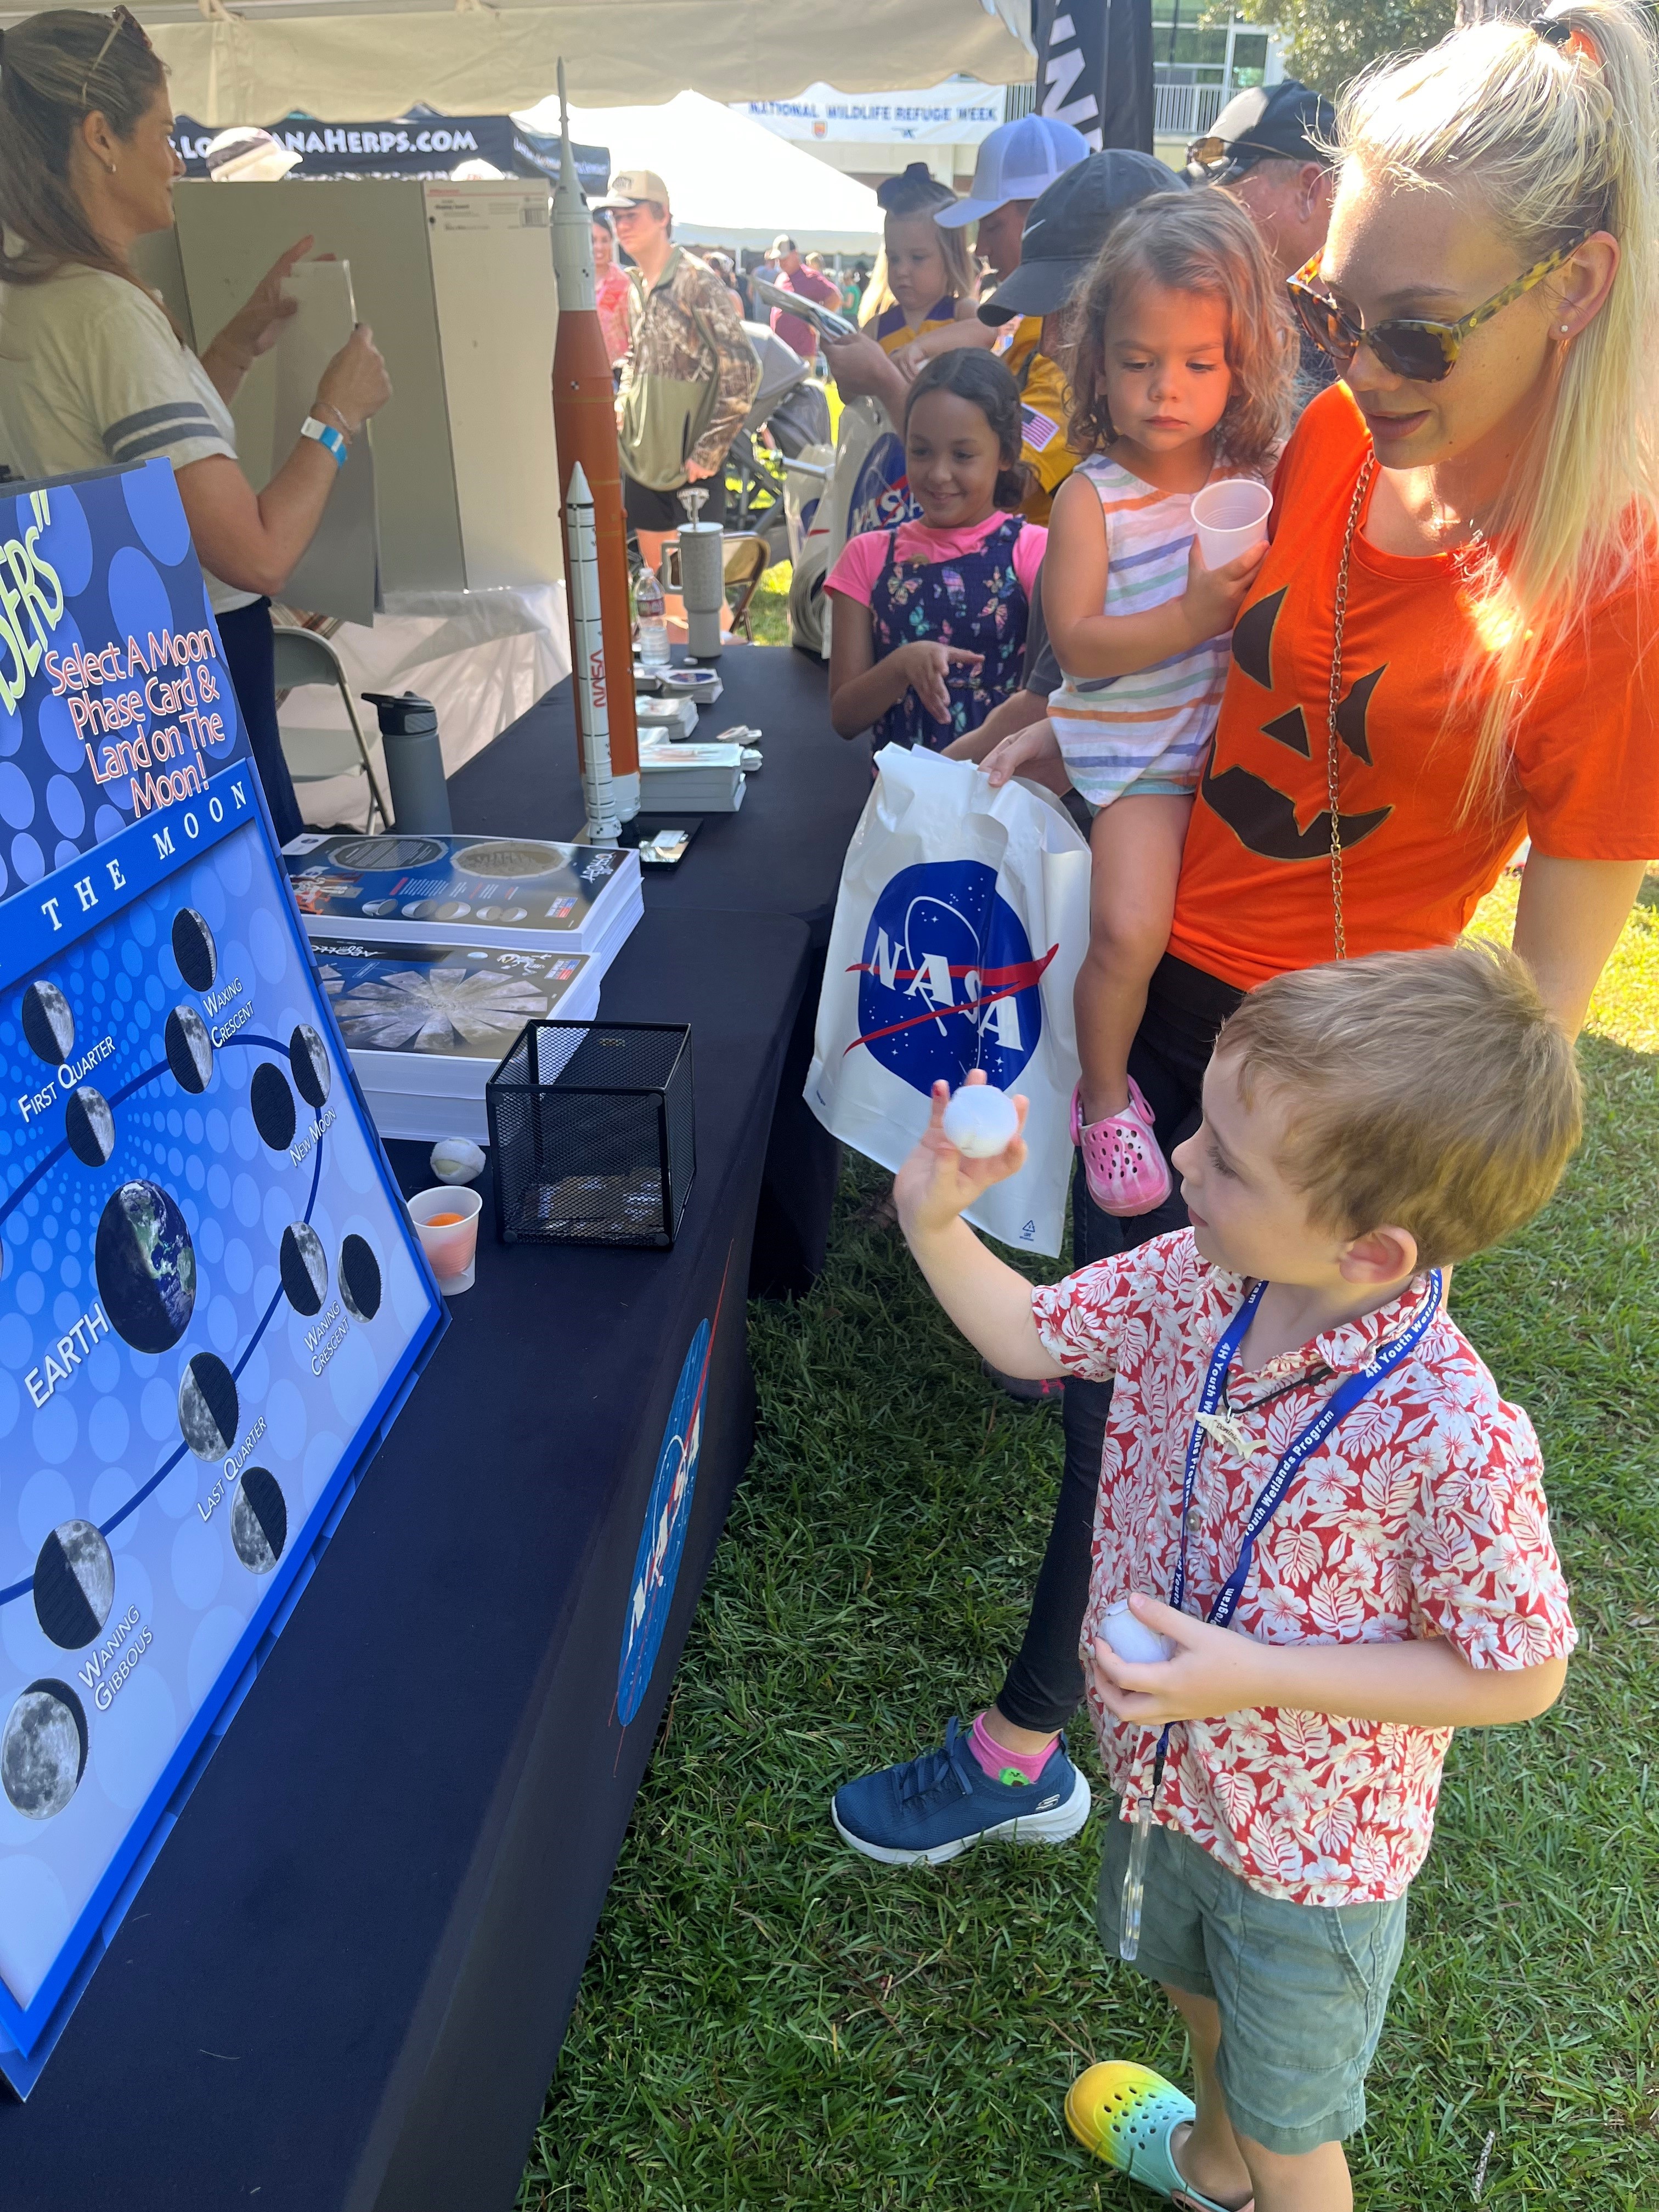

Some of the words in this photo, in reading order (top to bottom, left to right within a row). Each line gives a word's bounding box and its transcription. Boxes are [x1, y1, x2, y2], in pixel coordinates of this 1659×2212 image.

[749, 101, 819, 118] NATIONAL
[826, 104, 891, 121] WILDLIFE
[894, 106, 951, 122] REFUGE
[958, 106, 997, 122] WEEK
[45, 642, 126, 696] Select
[128, 635, 150, 677] A
[148, 629, 216, 672] Moon
[590, 649, 607, 708] NASA
[67, 690, 146, 740] Phase
[145, 665, 198, 715] Card
[196, 664, 220, 703] &
[86, 724, 152, 785] Land
[151, 725, 185, 762] on
[179, 707, 225, 750] The
[131, 752, 210, 819] Moon!
[41, 859, 126, 931] THE
[153, 781, 247, 860] MOON
[202, 977, 242, 1018] WAXING
[868, 926, 1024, 1052] NASA
[211, 1001, 256, 1048] CRESCENT
[18, 1081, 58, 1124] FIRST
[58, 1035, 116, 1090] QUARTER
[289, 1137, 312, 1167] NEW
[308, 1107, 337, 1144] MOON
[24, 1302, 110, 1409] EARTH
[303, 1300, 341, 1353] WANING
[309, 1317, 350, 1378] CRESCENT
[1217, 1342, 1231, 1359] 4H
[1365, 1363, 1382, 1378] 4H
[1379, 1333, 1413, 1363] Youth
[1411, 1279, 1439, 1333] Wetlands
[1206, 1363, 1224, 1397] Youth
[196, 1479, 228, 1522] LAST
[222, 1415, 268, 1481] QUARTER
[1261, 1455, 1296, 1507] Wetlands
[1292, 1410, 1334, 1456] Program
[1174, 1572, 1182, 1605] Youth
[78, 1604, 140, 1689] WANING
[94, 1626, 154, 1712] GIBBOUS
